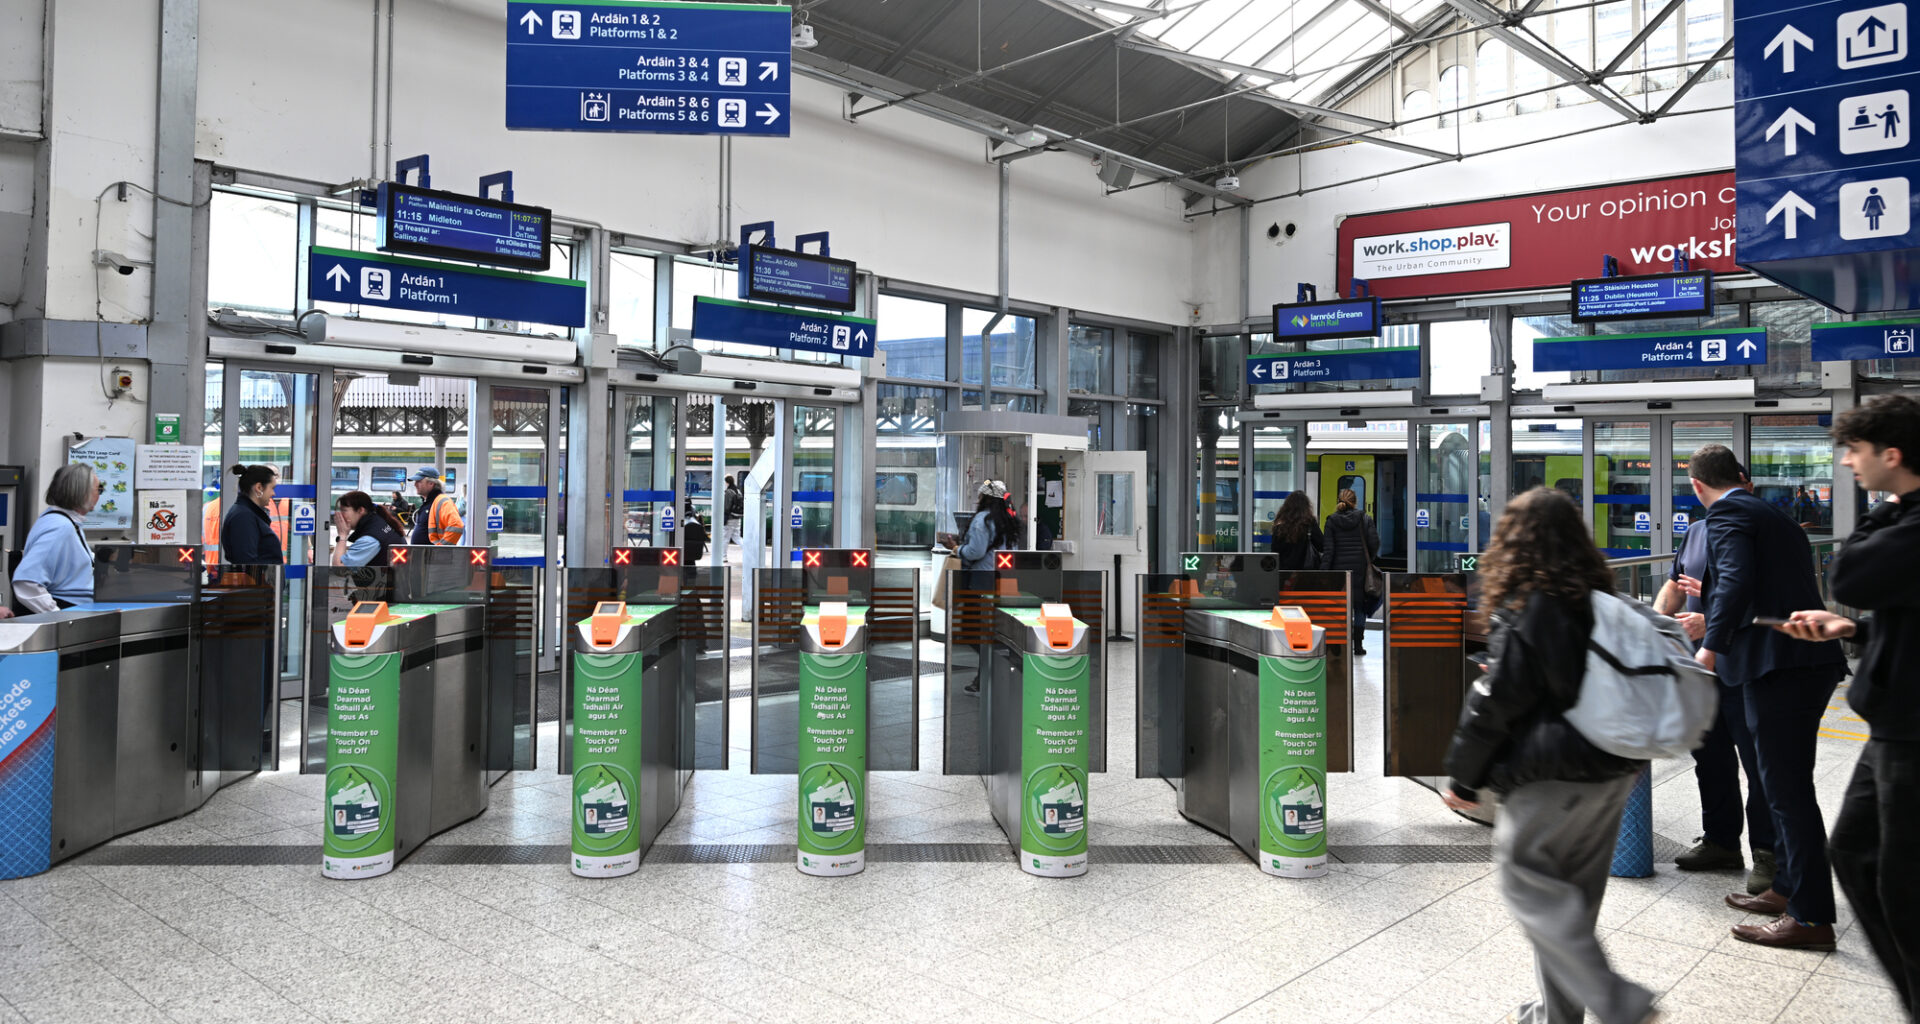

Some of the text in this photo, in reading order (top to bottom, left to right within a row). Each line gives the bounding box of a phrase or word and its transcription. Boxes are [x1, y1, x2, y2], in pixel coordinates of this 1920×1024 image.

[591, 13, 660, 25] Ardáin 1 & 2
[590, 26, 678, 39] Platforms 1 & 2
[638, 55, 709, 67] Ardáin 3 & 4
[619, 69, 709, 82] Platforms 3 & 4
[638, 95, 709, 108] Ardáin 5 & 6
[619, 109, 709, 122] Platforms 5 & 6
[400, 196, 404, 204] 1
[429, 202, 462, 213] Mainistir
[475, 209, 502, 220] Corann
[1532, 203, 1591, 224] Your
[1600, 189, 1706, 219] opinion
[397, 210, 422, 221] 11:15
[429, 214, 462, 226] Midleton
[514, 214, 542, 224] 11:07:37
[405, 224, 430, 234] freastal
[394, 232, 417, 243] Calling
[1396, 262, 1424, 270] Urban
[1428, 257, 1482, 268] Community
[755, 266, 772, 275] 11:30
[401, 273, 444, 288] Ardán 1
[400, 288, 458, 304] Platform 1
[1627, 291, 1659, 299] (Heuston)
[1310, 310, 1363, 321] Iarnród Éireann
[800, 322, 829, 334] Ardán 2
[1311, 319, 1339, 328] Irish Rail
[790, 332, 828, 345] Platform 2
[1654, 340, 1694, 351] Ardán 4
[1642, 351, 1694, 362] Platform 4
[1294, 360, 1314, 368] Ardán
[1294, 369, 1324, 377] Platform
[587, 686, 619, 694] Ná Déan
[814, 694, 848, 702] Dearmad
[339, 714, 356, 722] agus
[817, 712, 834, 720] agus
[1048, 714, 1066, 722] agus
[580, 728, 617, 736] Remember
[807, 726, 846, 735] Remember
[1036, 728, 1076, 737] Remember
[585, 737, 606, 745] Touch
[813, 736, 835, 744] Touch
